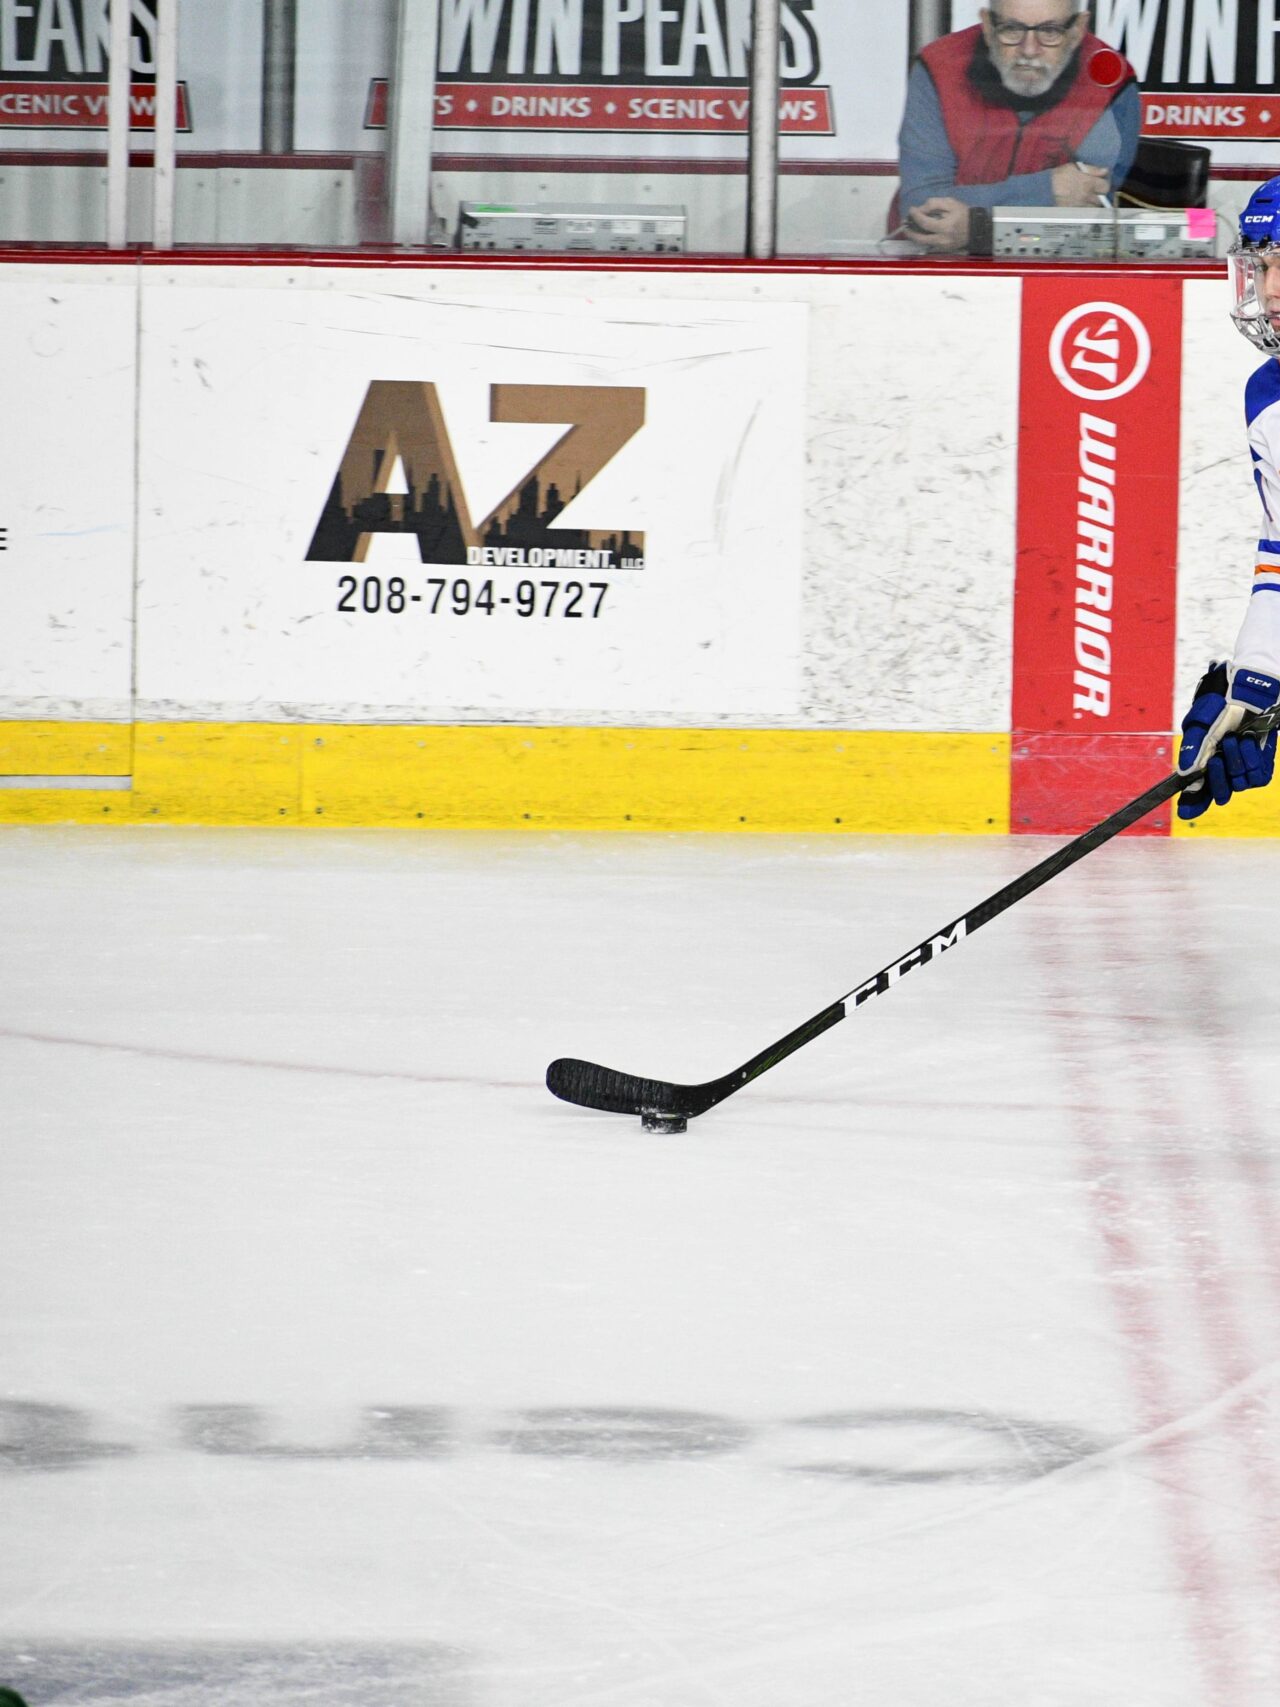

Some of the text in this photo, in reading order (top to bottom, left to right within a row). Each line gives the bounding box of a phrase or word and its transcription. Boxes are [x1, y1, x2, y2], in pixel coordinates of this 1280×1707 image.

[491, 96, 817, 121] DRINKS SCENIC VWS
[1145, 105, 1246, 127] DRINKS
[1244, 215, 1274, 224] CCM
[304, 380, 646, 564] AZ
[1073, 412, 1118, 720] WARRIOR
[337, 575, 609, 618] 208-794-9727
[1246, 676, 1272, 688] CCM
[842, 917, 966, 1018] CCM
